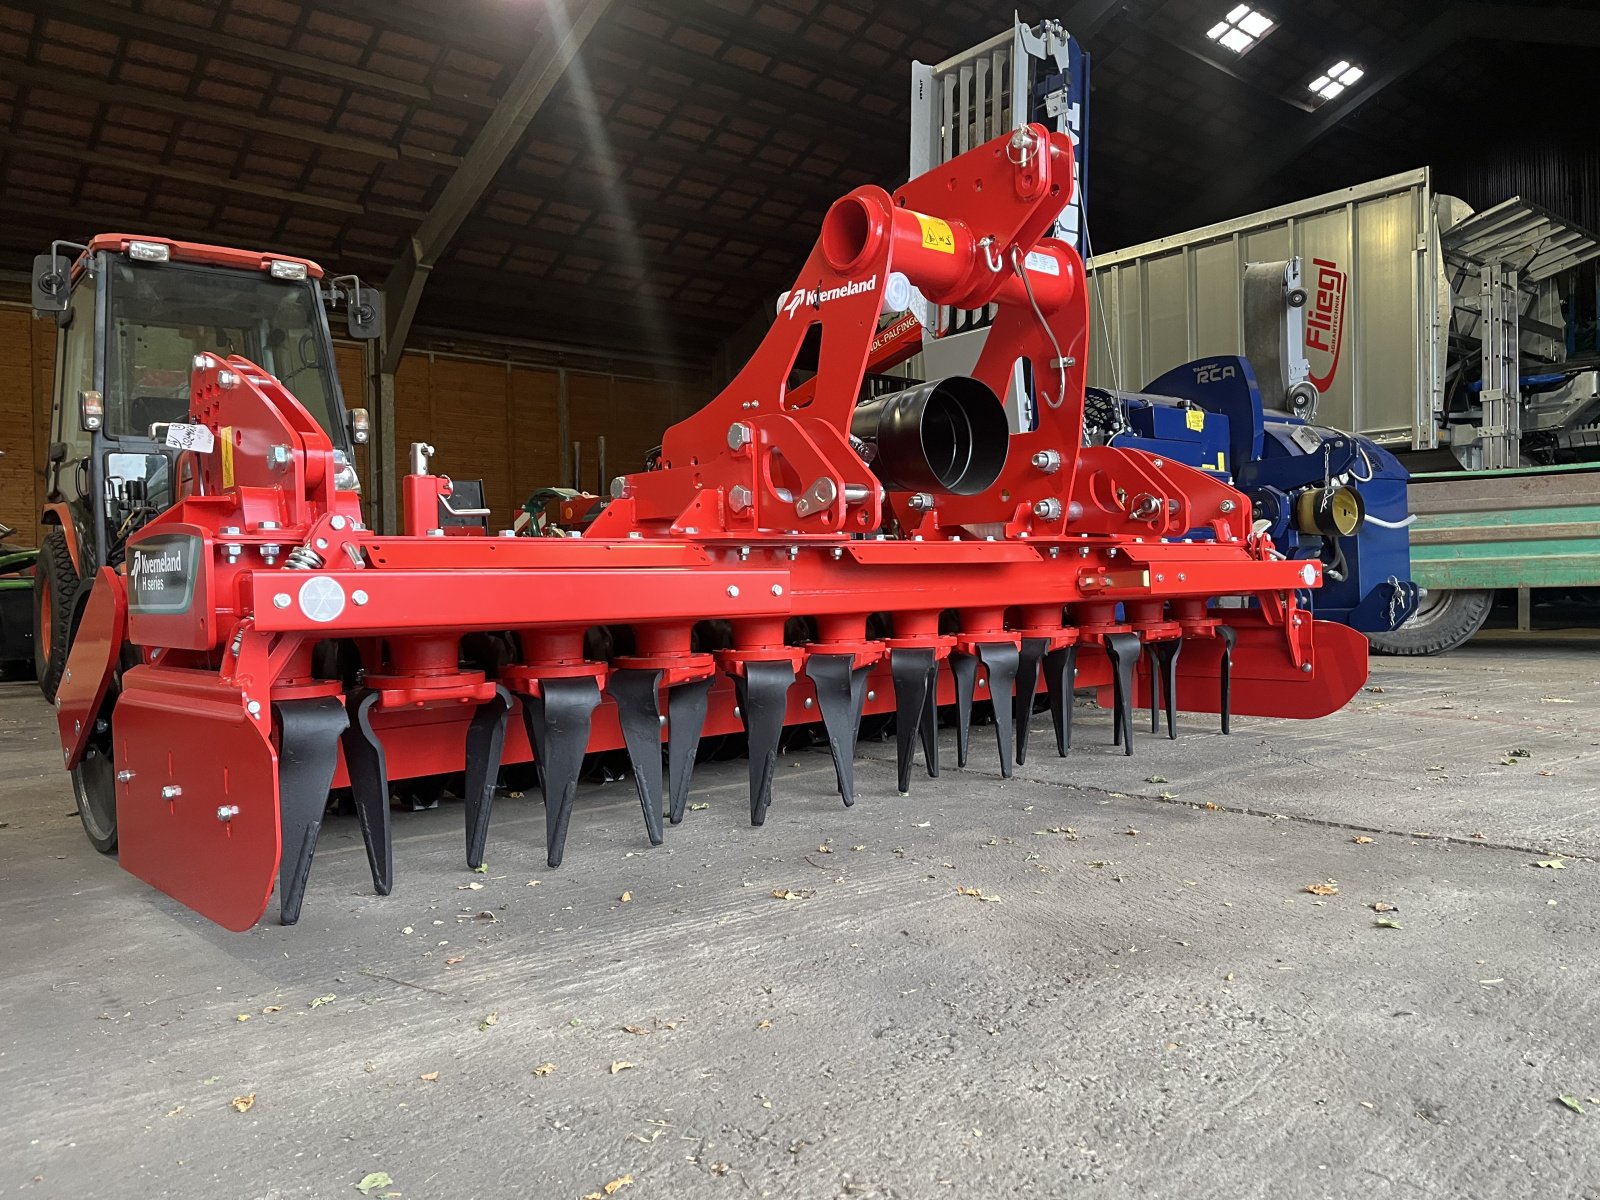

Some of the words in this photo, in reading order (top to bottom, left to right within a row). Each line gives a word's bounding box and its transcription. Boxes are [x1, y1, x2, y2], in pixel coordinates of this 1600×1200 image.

[805, 274, 877, 306] Kverneland
[1305, 257, 1342, 353] Fliegl
[1330, 294, 1341, 356] AGRARTECHNIK
[1196, 365, 1236, 385] RCA
[141, 550, 182, 574] Kverneland
[142, 576, 147, 591] H
[147, 575, 164, 591] series
